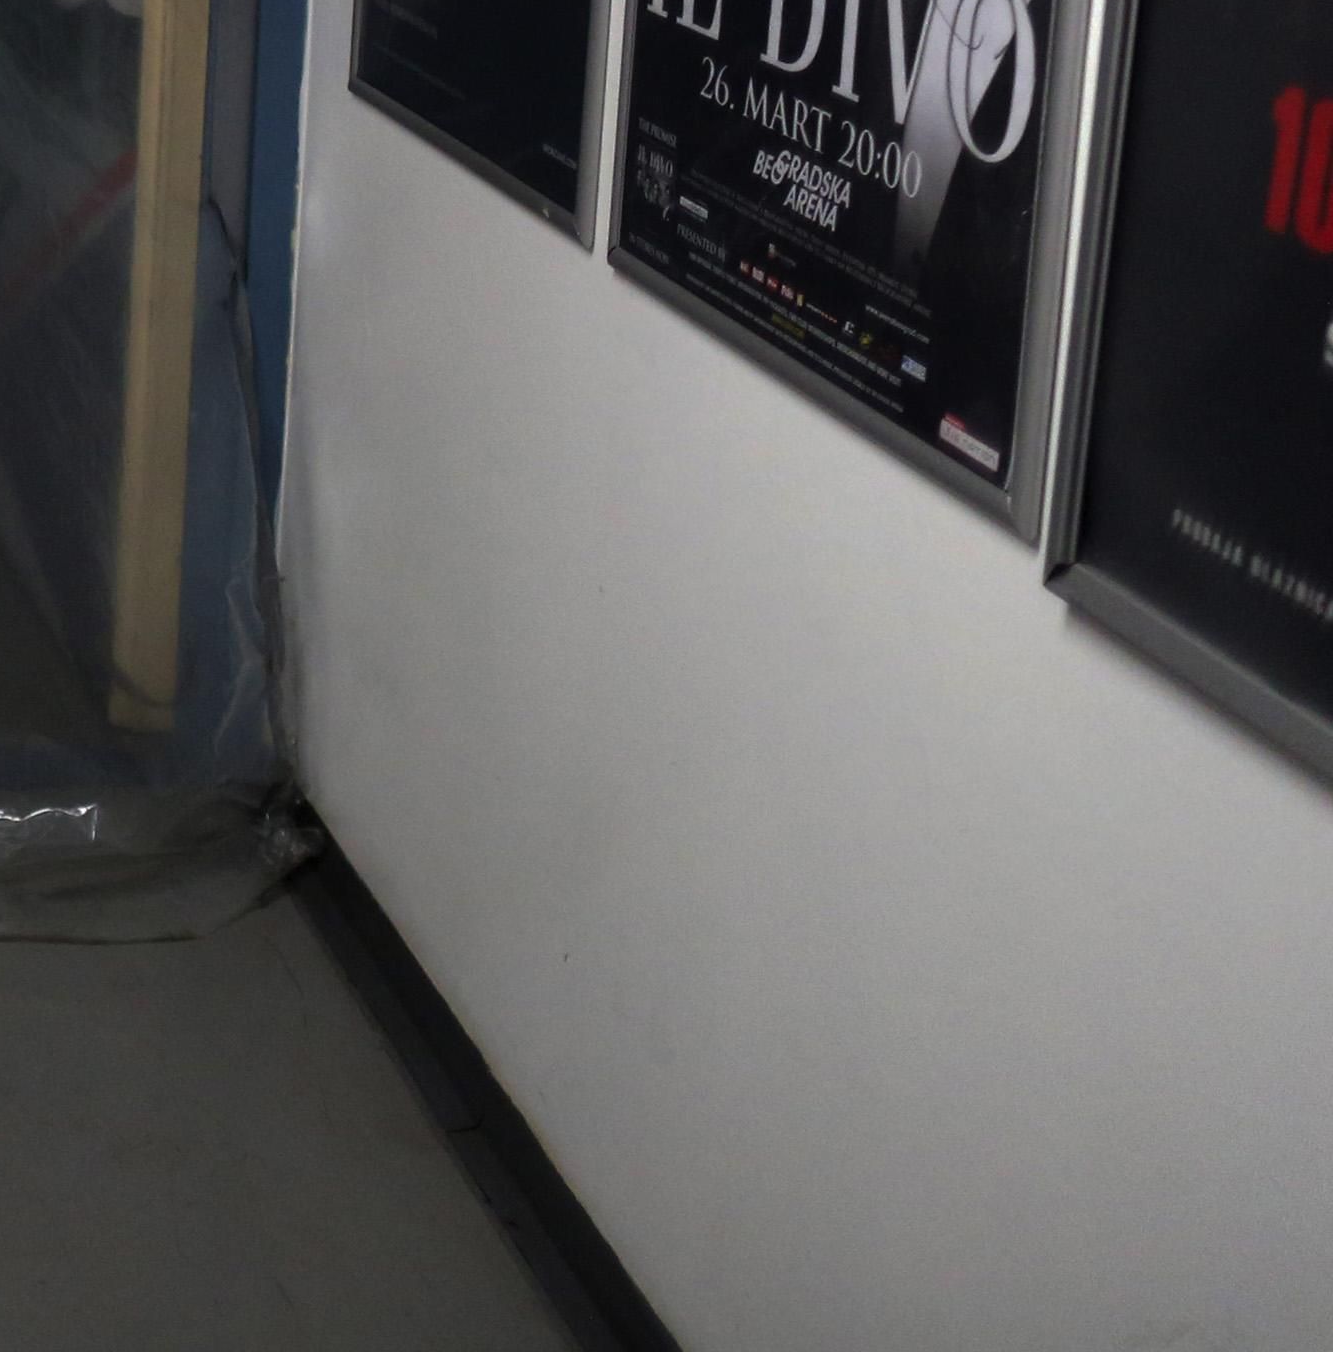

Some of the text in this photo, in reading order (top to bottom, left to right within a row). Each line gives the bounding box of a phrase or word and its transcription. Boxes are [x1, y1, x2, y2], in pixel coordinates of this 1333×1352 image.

[699, 56, 922, 198] 26. MART 20:00
[752, 149, 852, 210] BEOGRADSKA
[782, 183, 839, 232] ARENA
